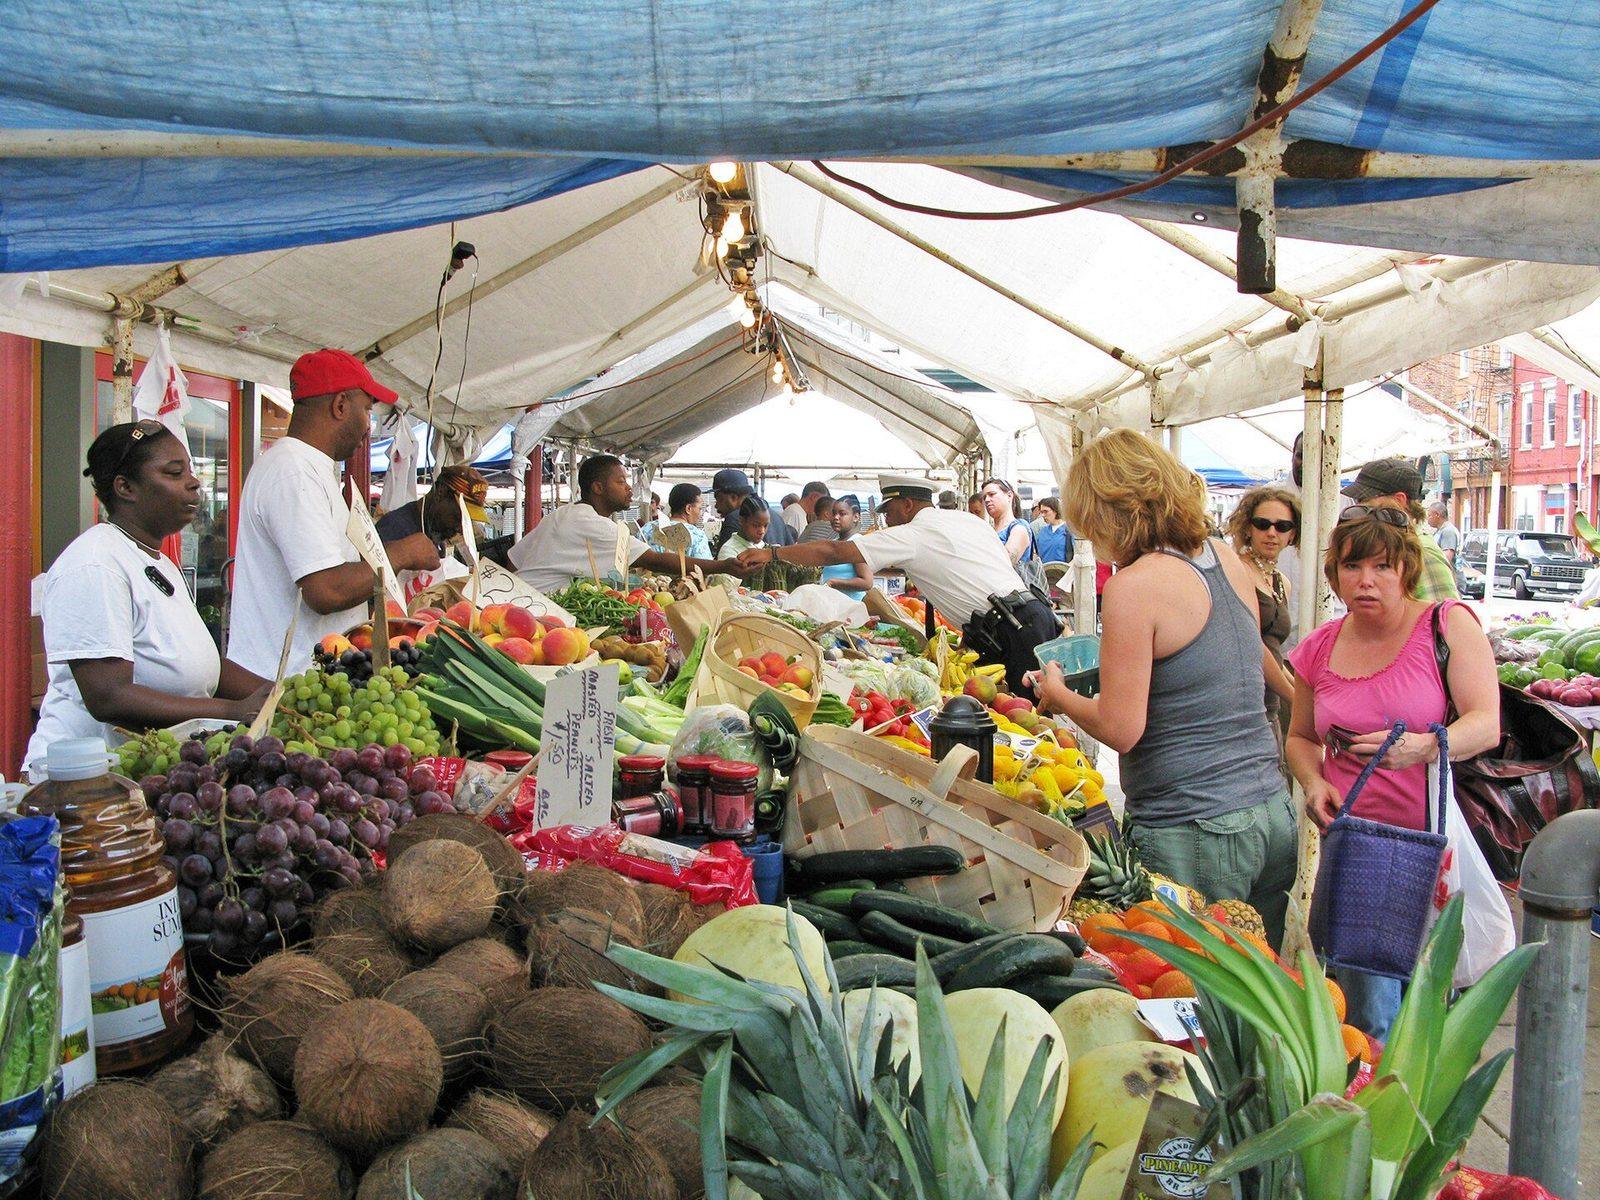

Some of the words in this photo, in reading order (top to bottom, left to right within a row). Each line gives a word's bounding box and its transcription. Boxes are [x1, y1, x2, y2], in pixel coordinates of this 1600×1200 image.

[587, 670, 599, 718] ROASTED
[569, 713, 581, 770] PEANUTS
[603, 710, 615, 745] FRESH
[584, 754, 594, 806] SALTED
